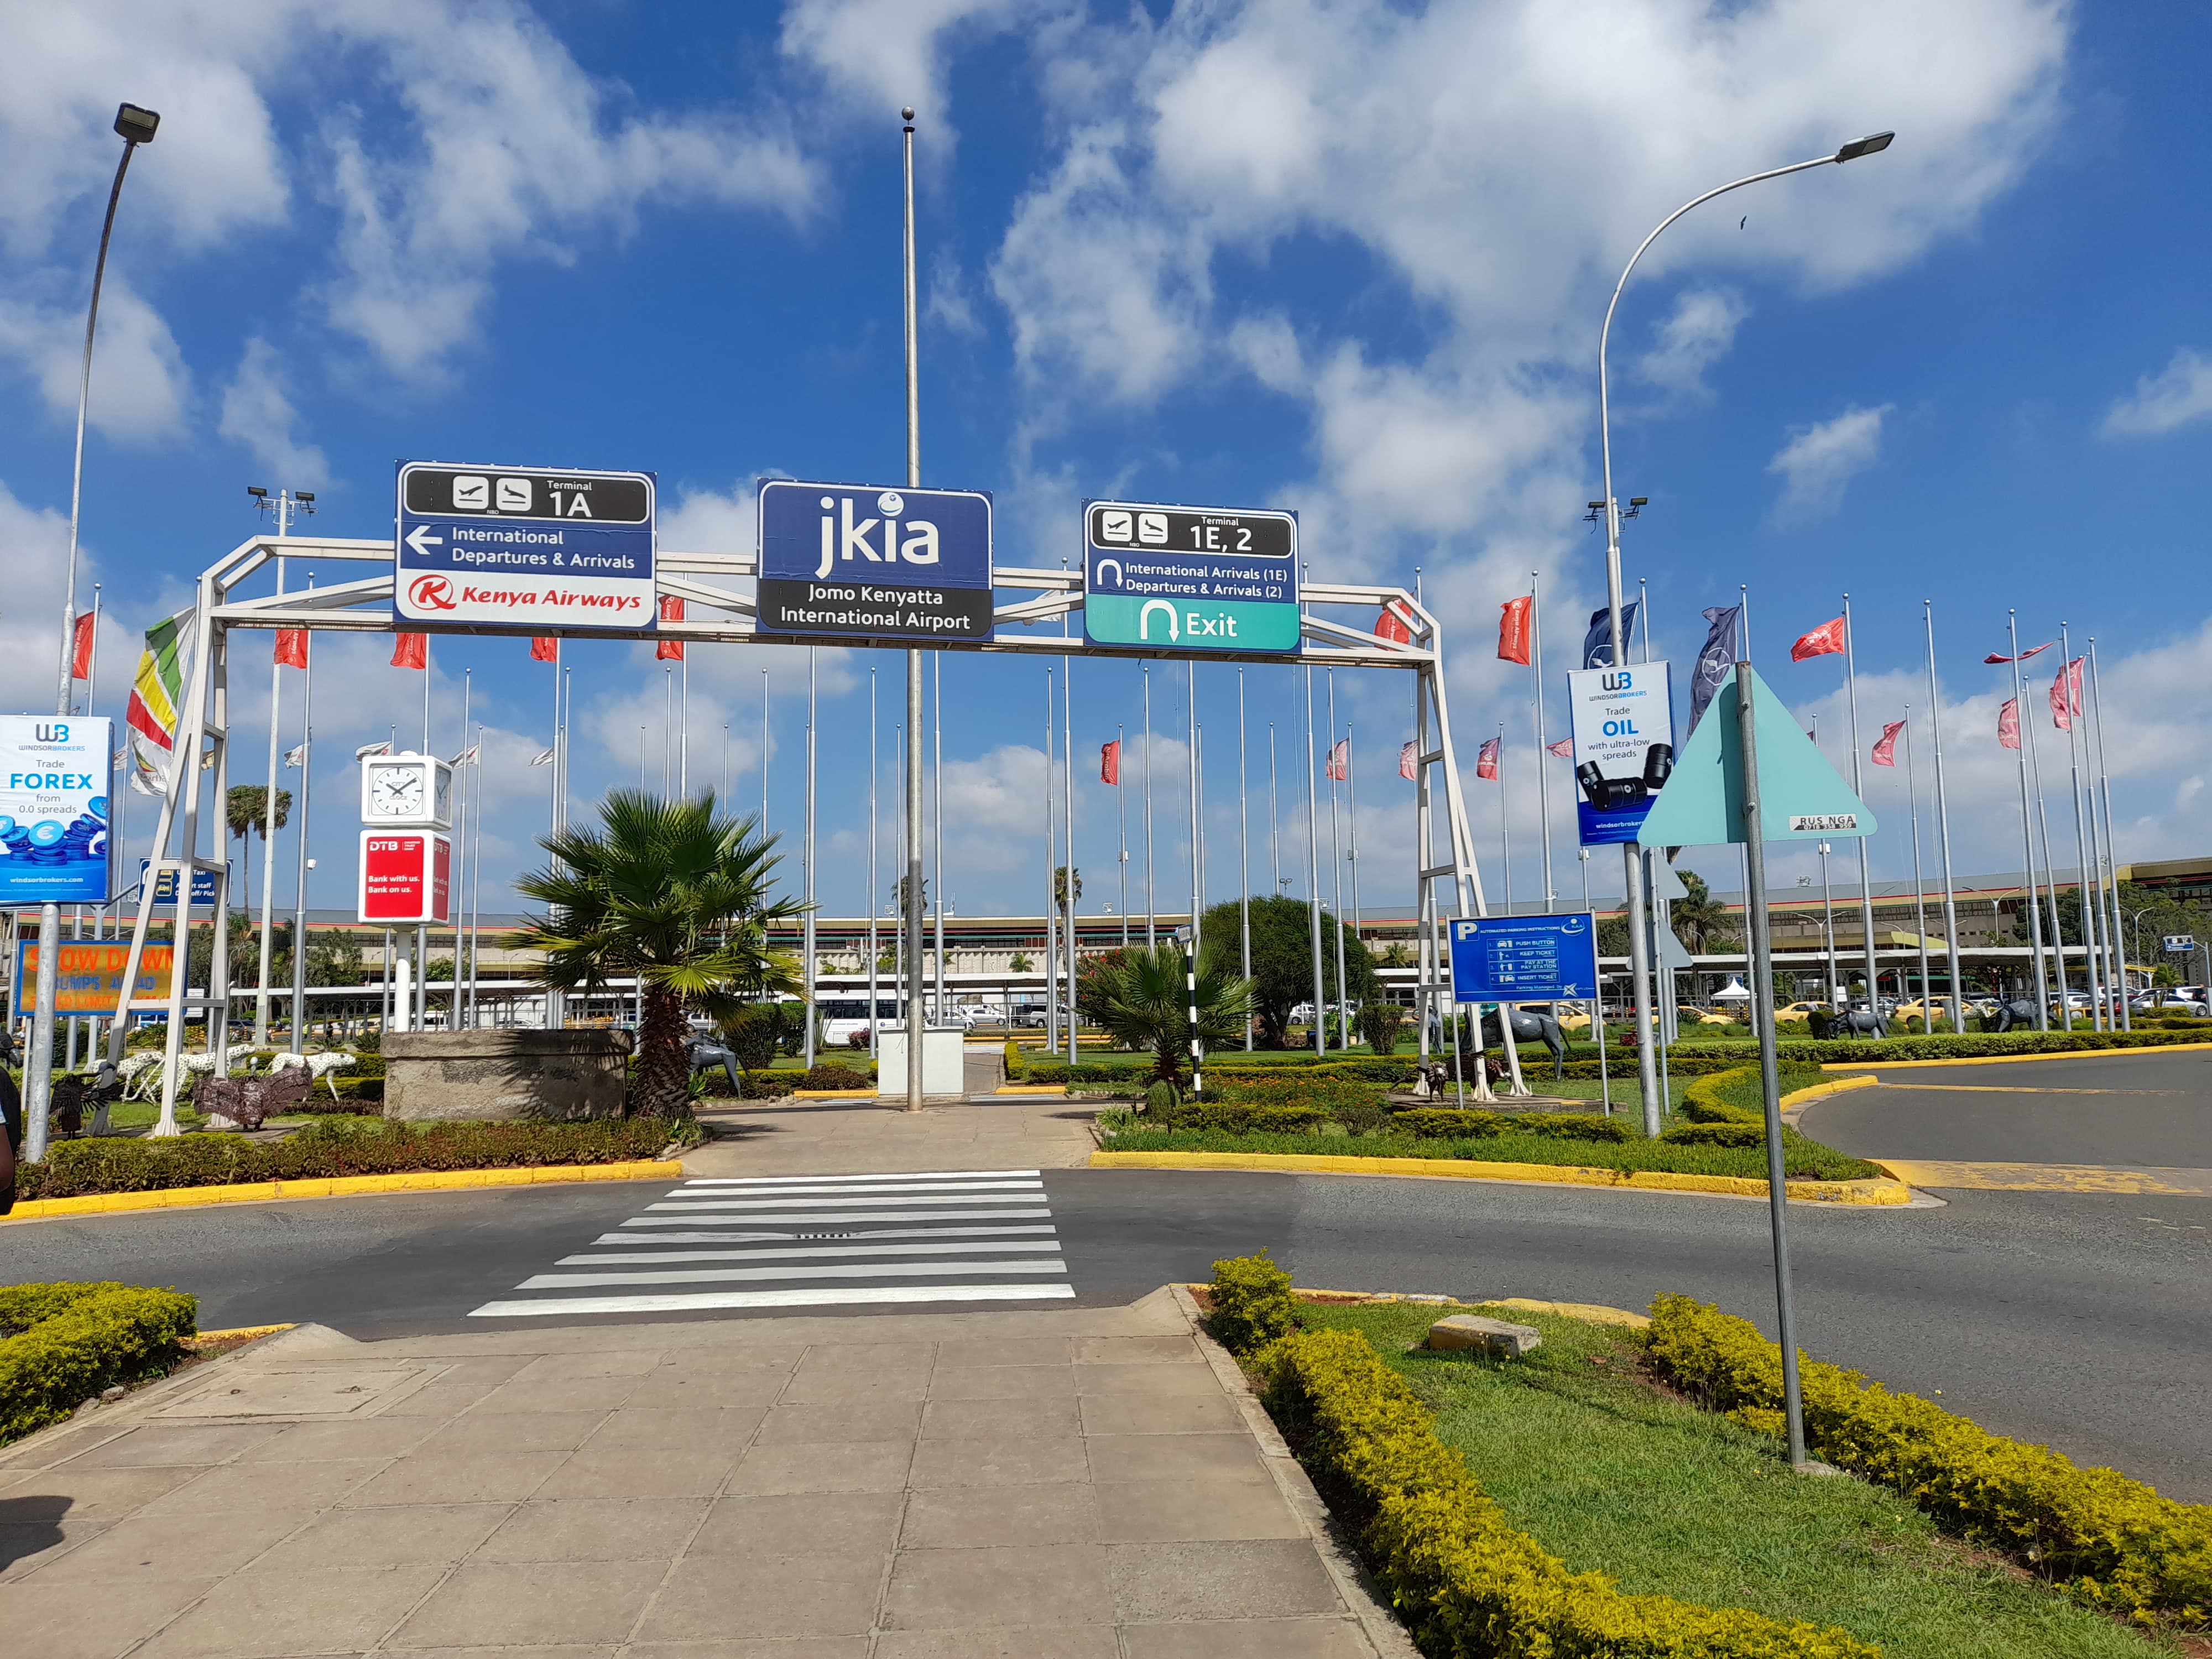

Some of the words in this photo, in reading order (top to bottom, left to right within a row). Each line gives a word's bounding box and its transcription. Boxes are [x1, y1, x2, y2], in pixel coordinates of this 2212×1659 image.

[546, 480, 592, 491] Terminal
[549, 492, 592, 518] 1A
[1201, 516, 1239, 526] Terminal
[452, 526, 564, 545] International
[815, 492, 940, 580] jkia
[1190, 525, 1228, 552] 1E,
[1236, 528, 1252, 551] 2
[452, 547, 547, 566] Departures
[552, 554, 565, 566] &
[570, 554, 635, 569] Arrivals
[1126, 562, 1208, 577] International
[1212, 567, 1260, 580] Arrivals
[1264, 569, 1288, 583] (1E)
[808, 584, 855, 602] Jomo
[862, 586, 943, 607] Kenyatta
[1126, 579, 1197, 594] Departures
[1200, 583, 1209, 594] &
[1213, 584, 1261, 597] Arrivals
[1265, 586, 1282, 599] (2)
[462, 587, 536, 607] Kenya
[541, 589, 641, 611] Airways
[781, 606, 901, 627] International
[906, 611, 971, 632] Airport
[1187, 612, 1238, 637] Exit
[1589, 690, 1647, 702] WINDSORBROKERS
[1605, 707, 1630, 716] Trade
[1603, 719, 1639, 737] OIL
[1588, 742, 1608, 751] with
[1610, 739, 1650, 749] ultra-low
[36, 760, 65, 768] Trade
[1602, 750, 1637, 760] spreads
[10, 774, 93, 790] FOREX
[36, 794, 60, 802] from
[19, 805, 34, 813] 0.0
[37, 805, 77, 816] spreads
[1801, 817, 1823, 825] RUS
[369, 841, 398, 851] DTB
[1457, 922, 1477, 940] P
[28, 947, 100, 972] SOW
